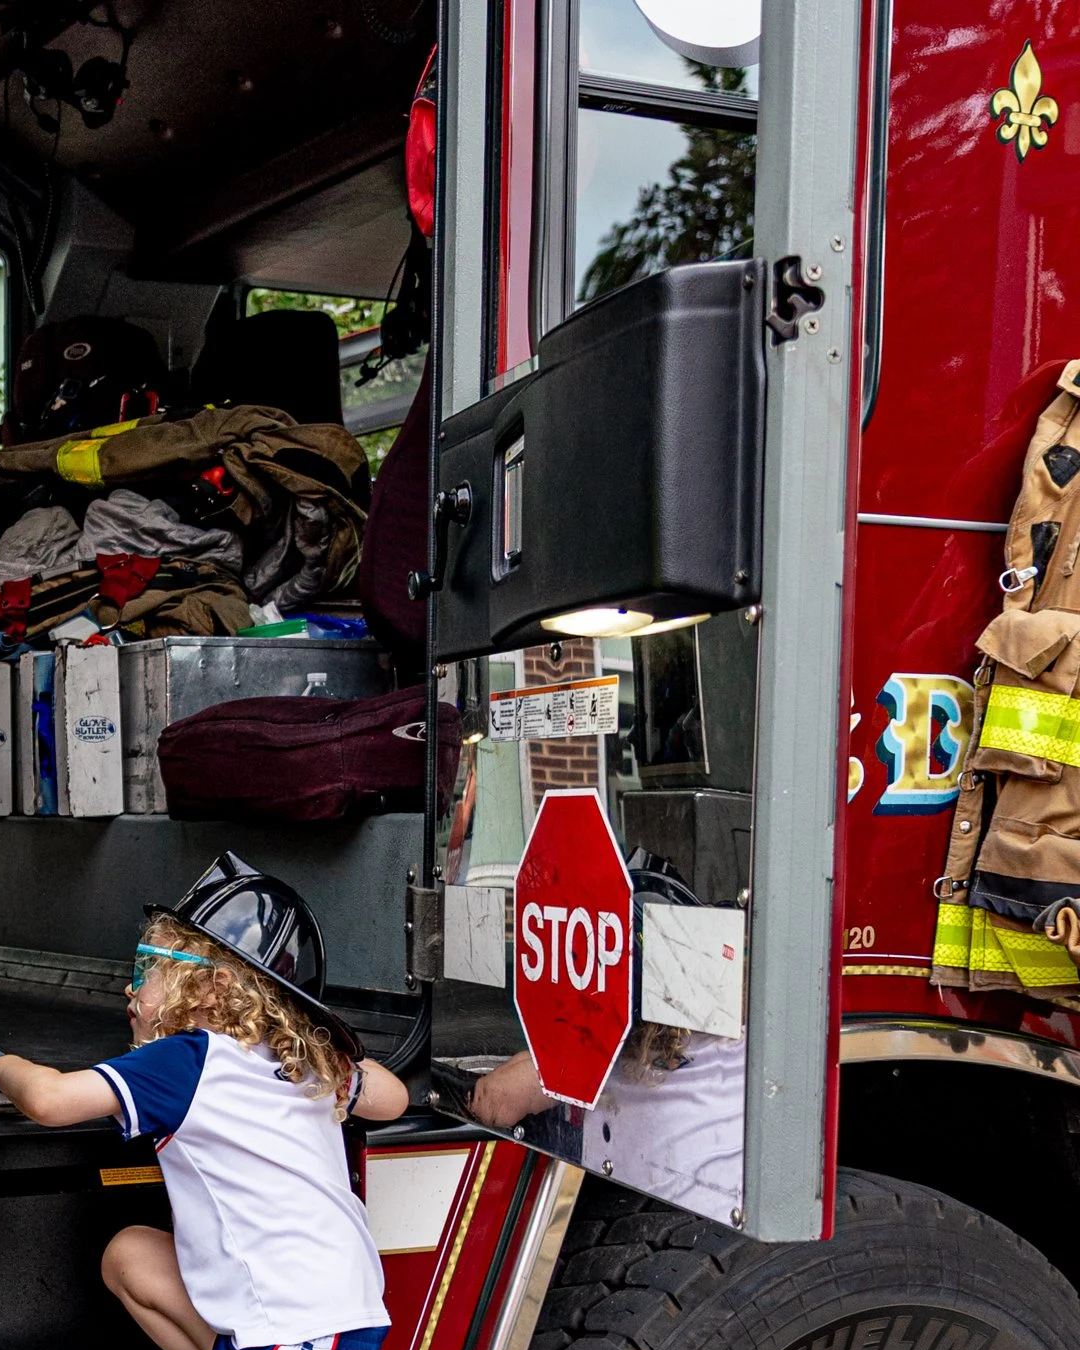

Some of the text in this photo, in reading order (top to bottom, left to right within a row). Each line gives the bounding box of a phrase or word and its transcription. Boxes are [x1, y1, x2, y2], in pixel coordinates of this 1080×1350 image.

[79, 717, 107, 727] GLOVE
[75, 726, 107, 735] BUTLER
[520, 901, 624, 992] STOP
